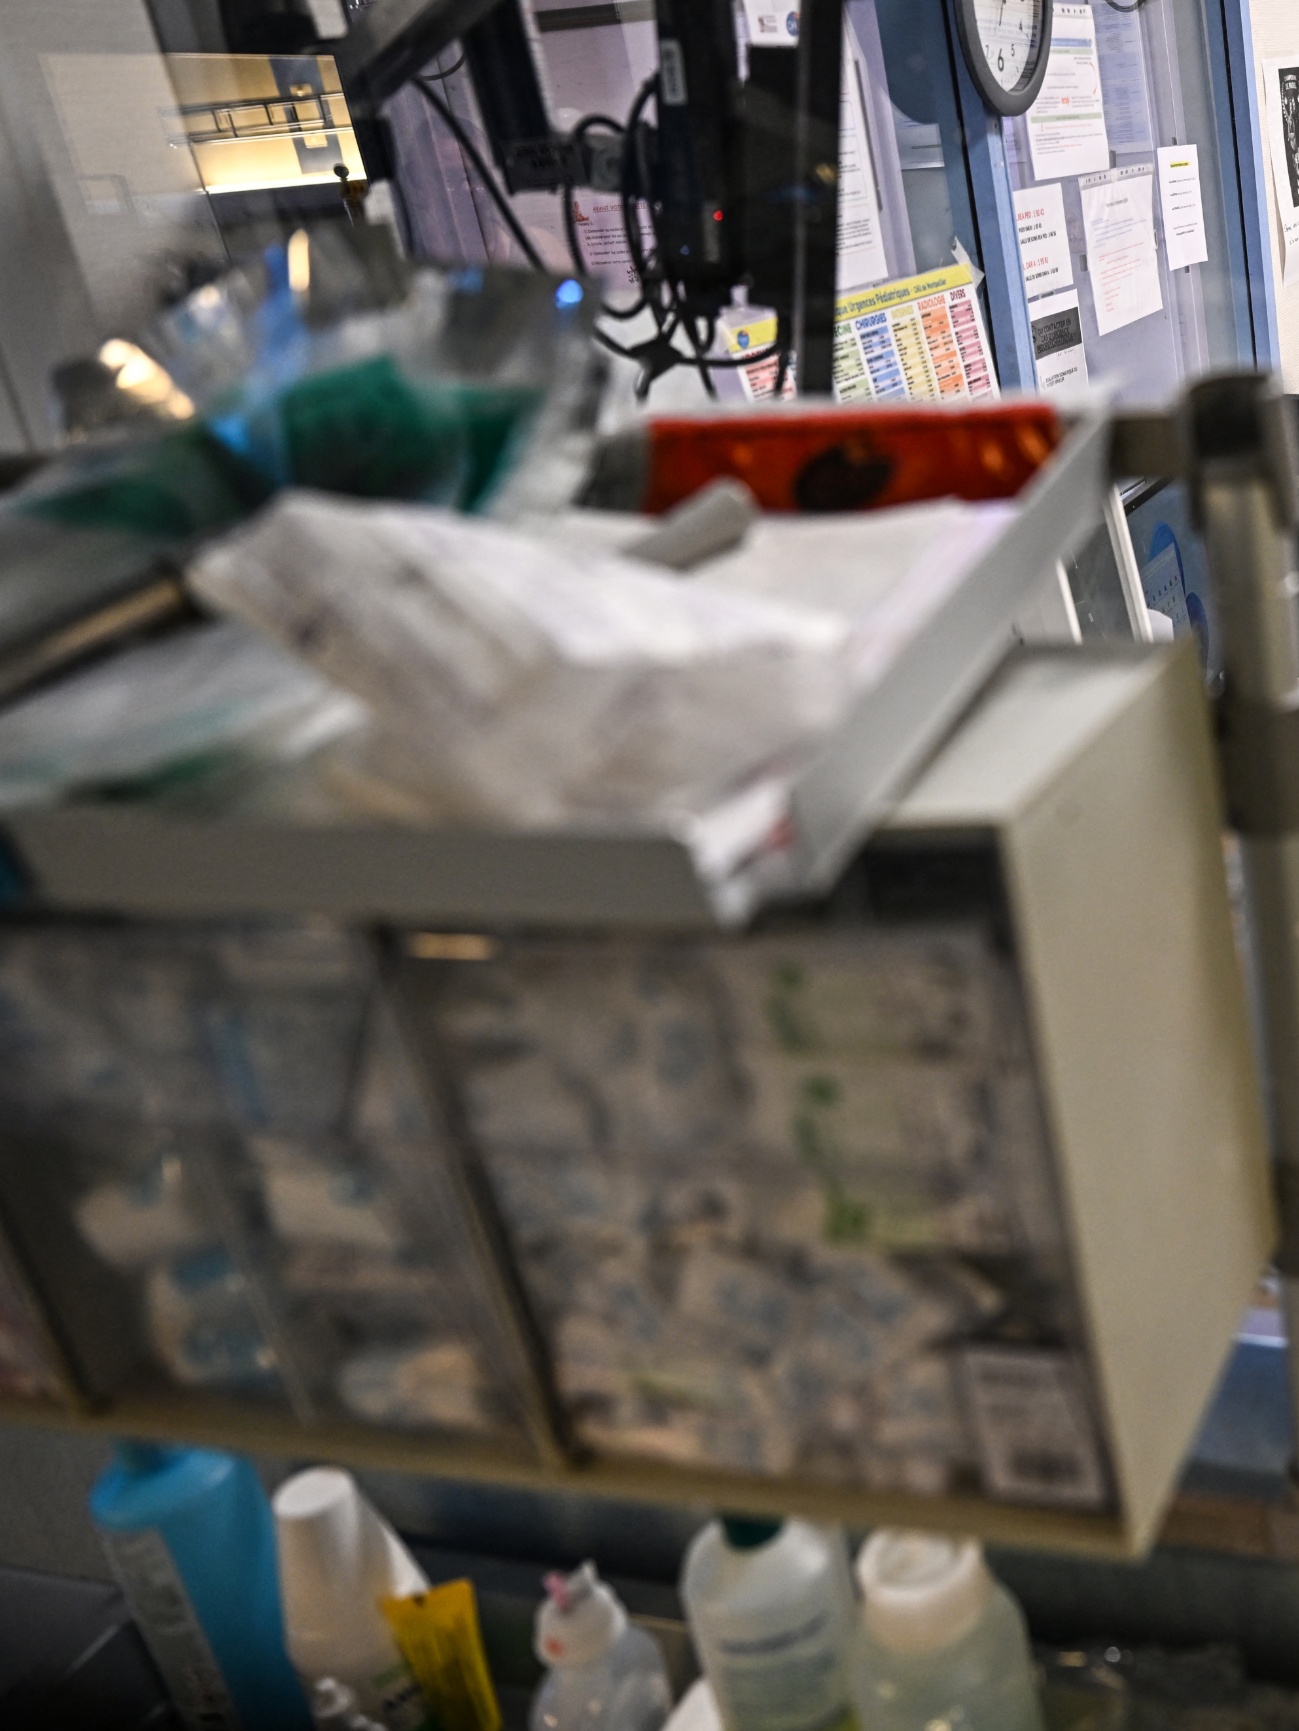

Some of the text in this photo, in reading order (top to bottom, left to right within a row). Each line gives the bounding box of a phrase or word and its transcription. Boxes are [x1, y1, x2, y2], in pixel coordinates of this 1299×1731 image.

[998, 49, 1004, 72] 6
[1011, 43, 1015, 57] 5
[917, 295, 946, 311] RADIOLOGIE
[951, 289, 966, 302] DIVERS
[855, 312, 887, 331] CHIRURGIES
